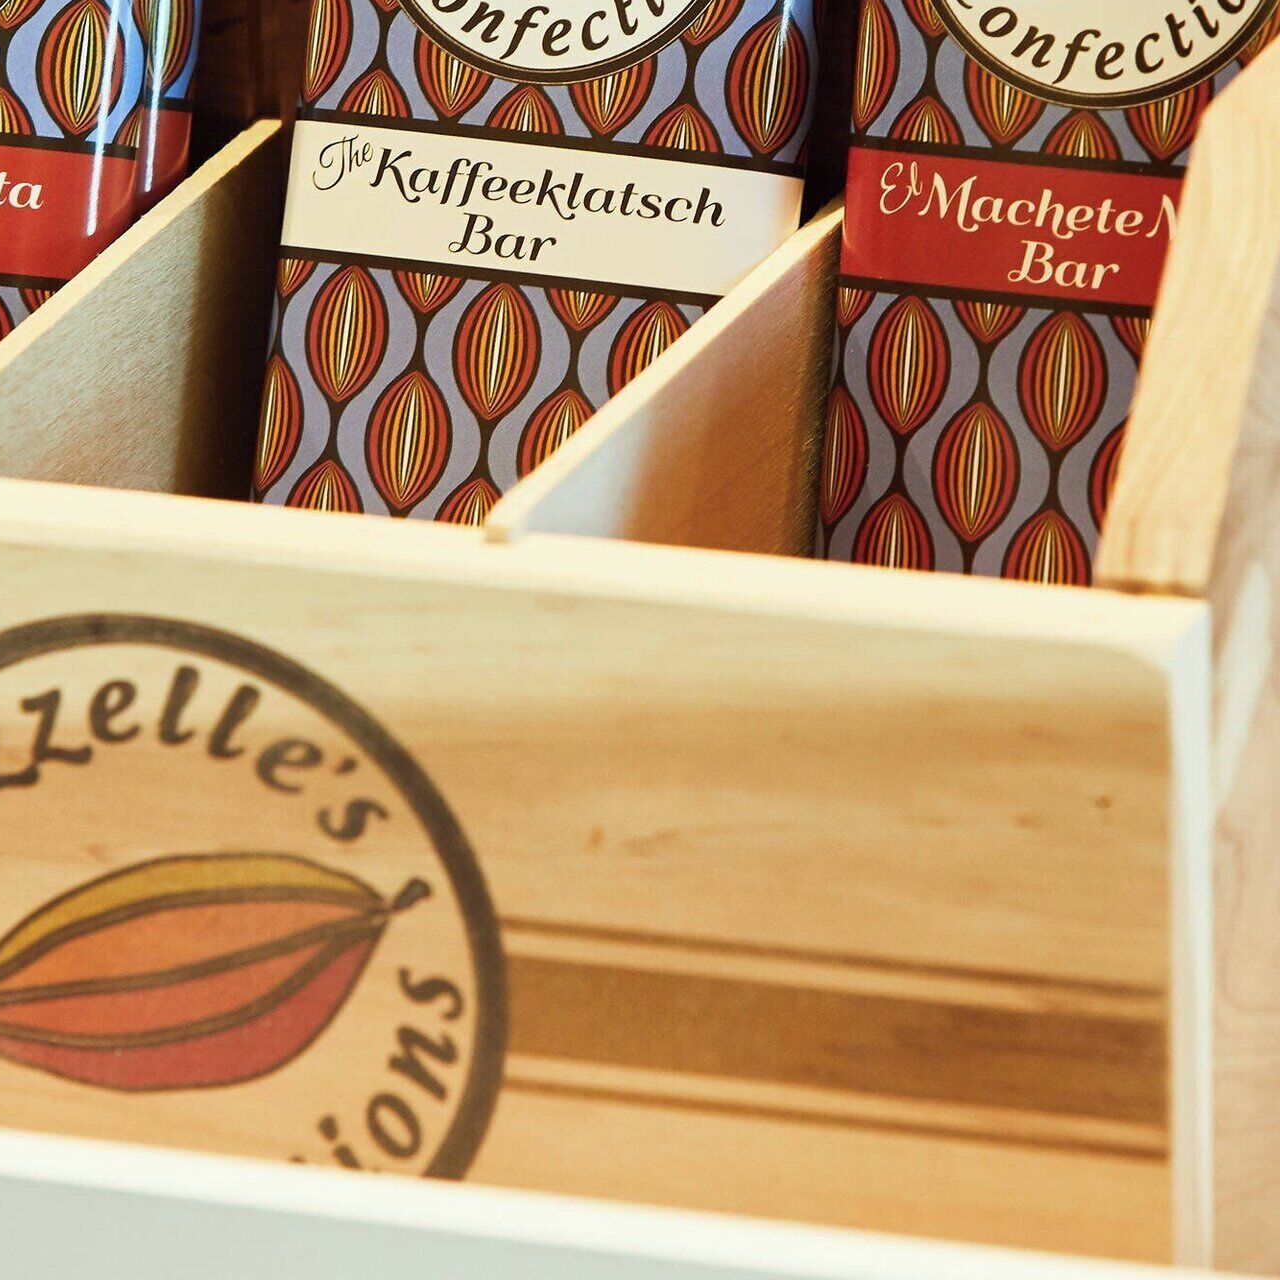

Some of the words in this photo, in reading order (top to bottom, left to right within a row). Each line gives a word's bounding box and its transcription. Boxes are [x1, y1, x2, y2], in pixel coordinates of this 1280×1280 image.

[312, 134, 373, 191] The
[370, 147, 726, 227] Kaffeeklatsch
[879, 161, 922, 215] El
[919, 173, 1140, 239] Machete
[450, 213, 556, 262] Bar
[1008, 239, 1119, 290] Bar
